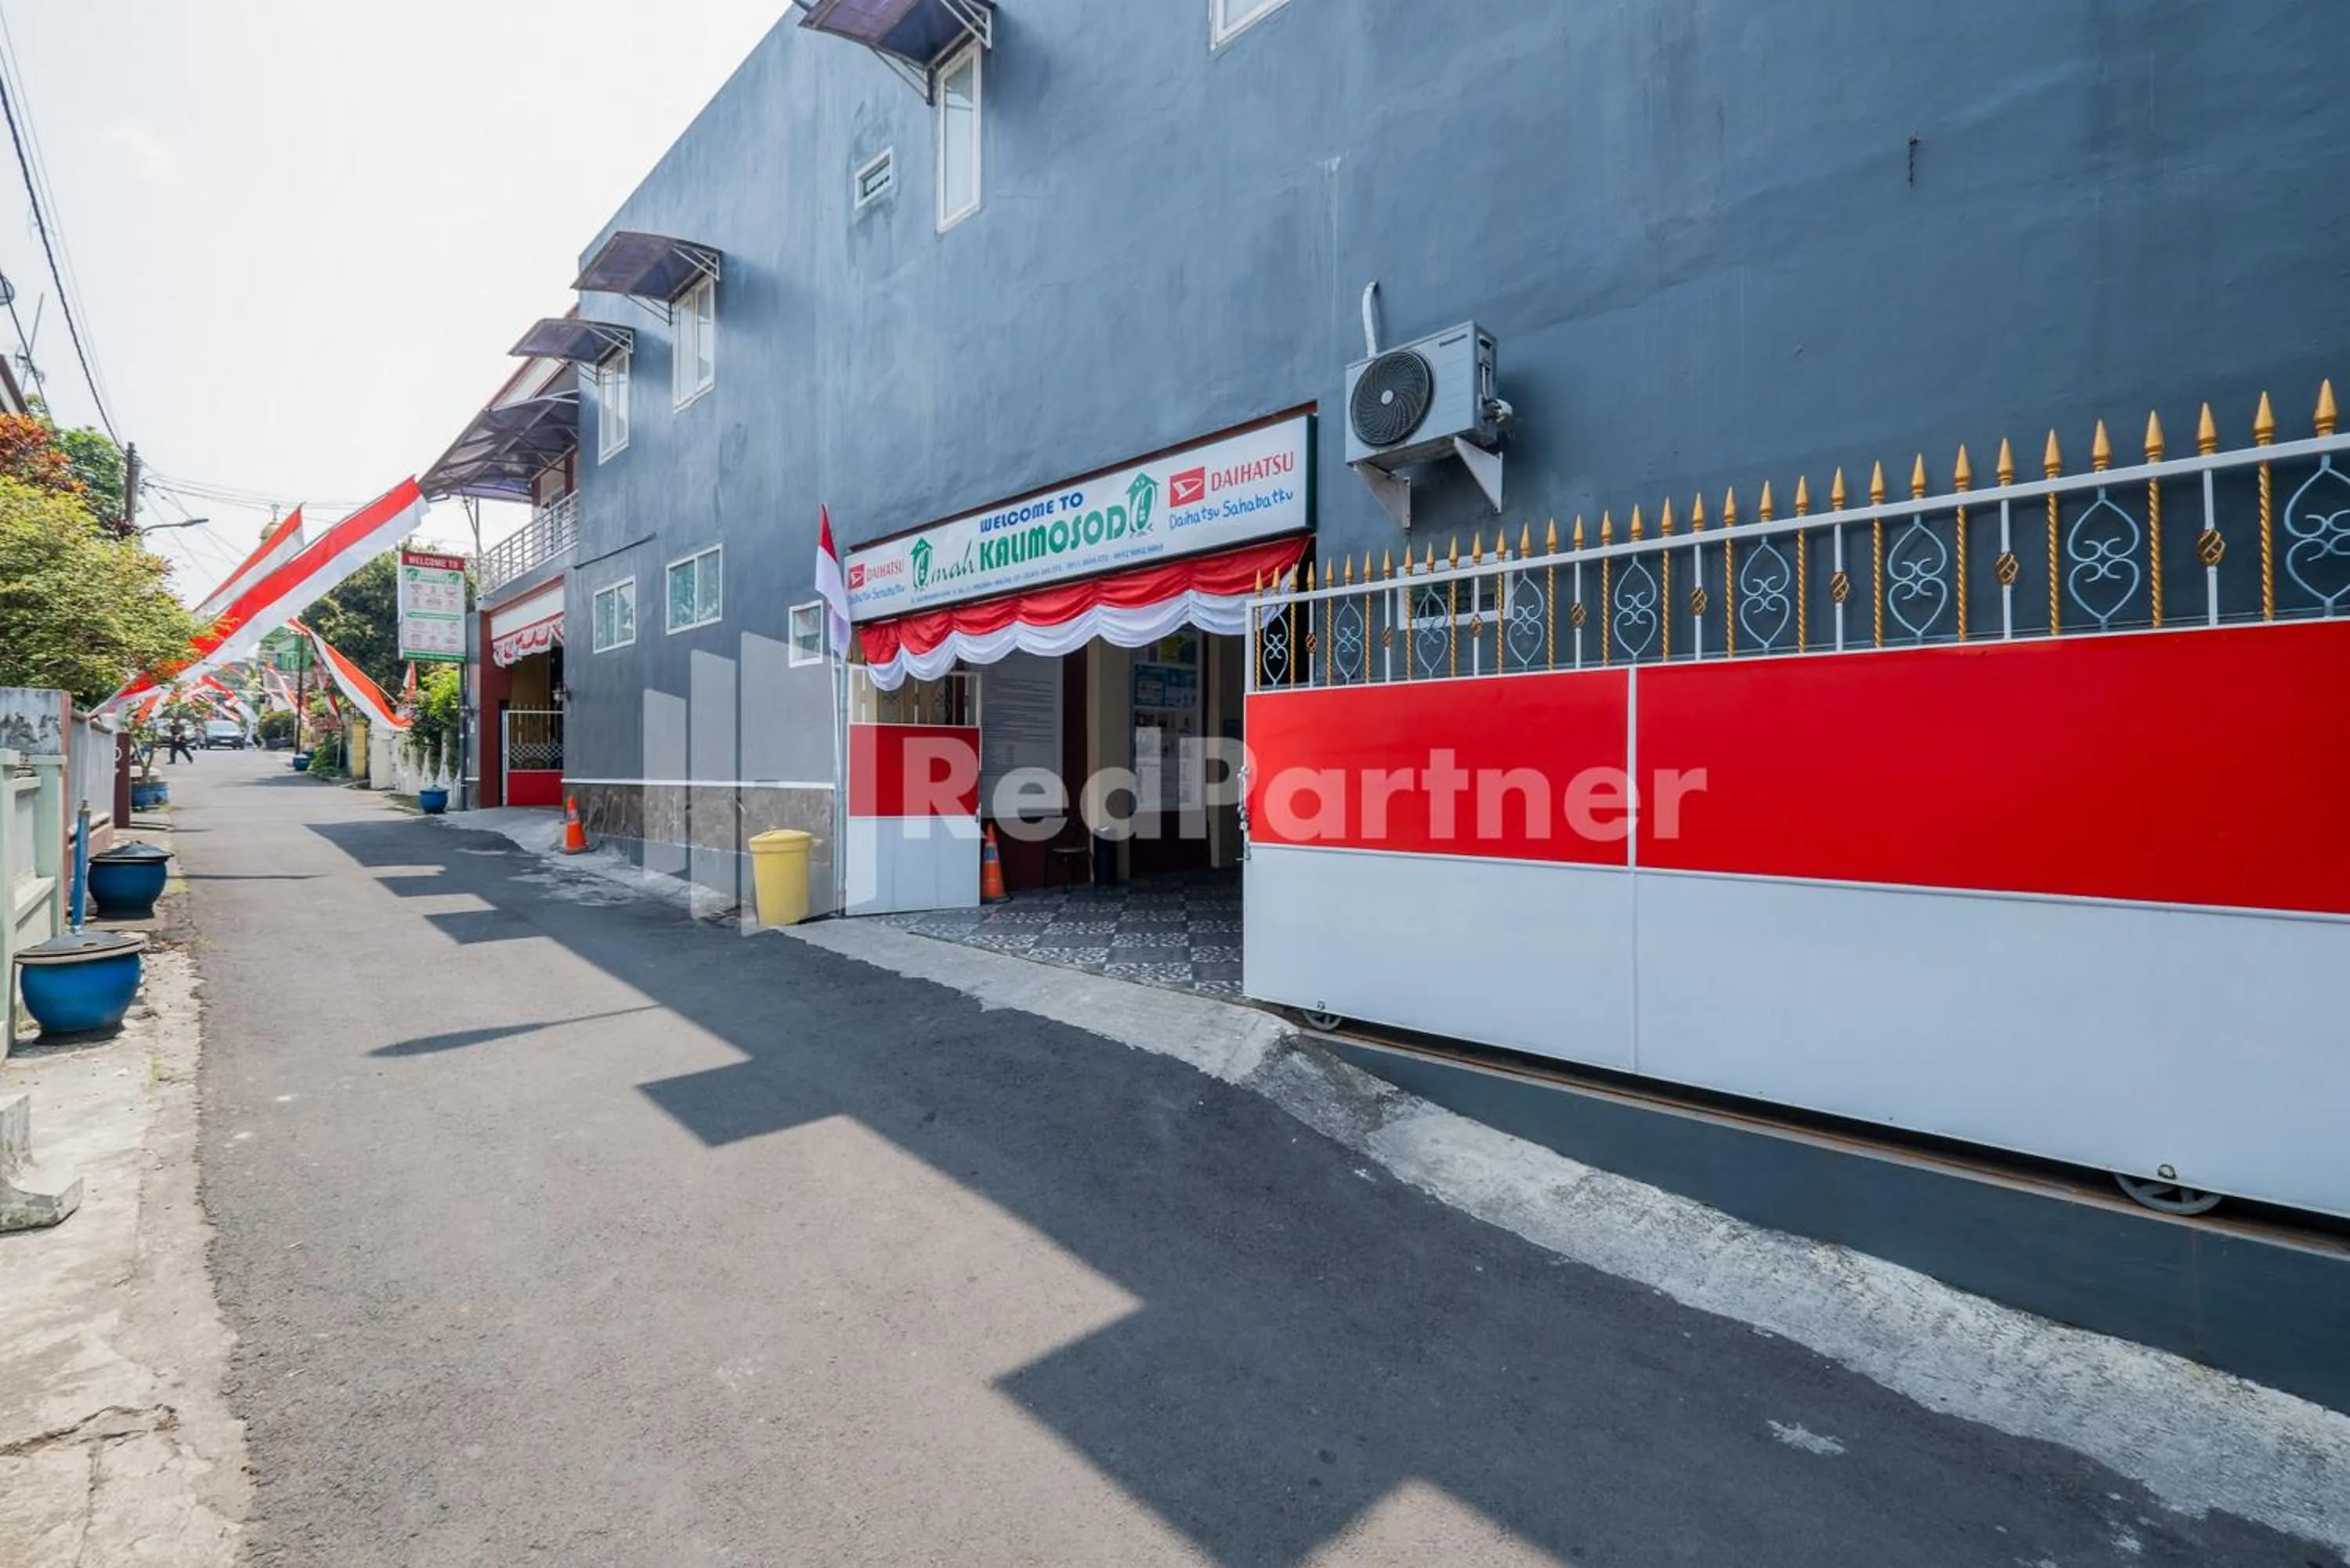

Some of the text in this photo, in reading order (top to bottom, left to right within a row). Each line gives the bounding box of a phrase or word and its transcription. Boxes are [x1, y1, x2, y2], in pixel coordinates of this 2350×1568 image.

[1211, 451, 1294, 491] DAIHATSU
[980, 492, 1083, 533] WELCOME TO
[1170, 504, 1220, 529] Daihatsu
